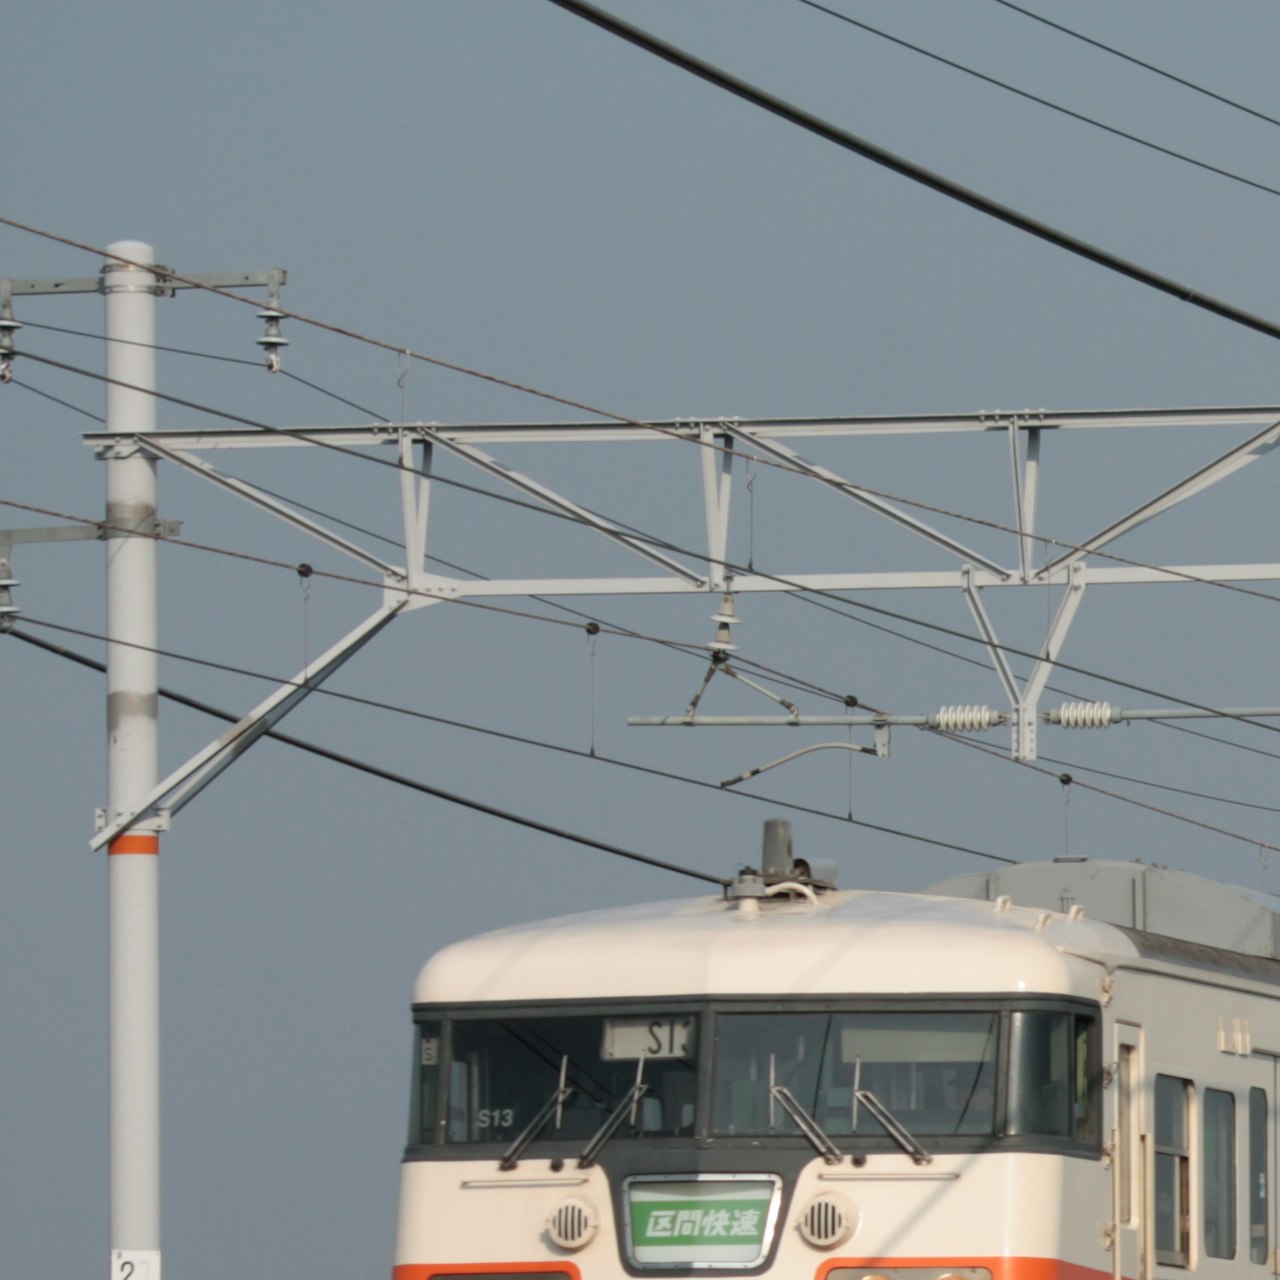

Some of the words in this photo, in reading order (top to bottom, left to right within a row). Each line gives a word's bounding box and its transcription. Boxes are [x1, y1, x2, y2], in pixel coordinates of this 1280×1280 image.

[479, 1109, 513, 1127] S13
[645, 1208, 761, 1237] 区間快速
